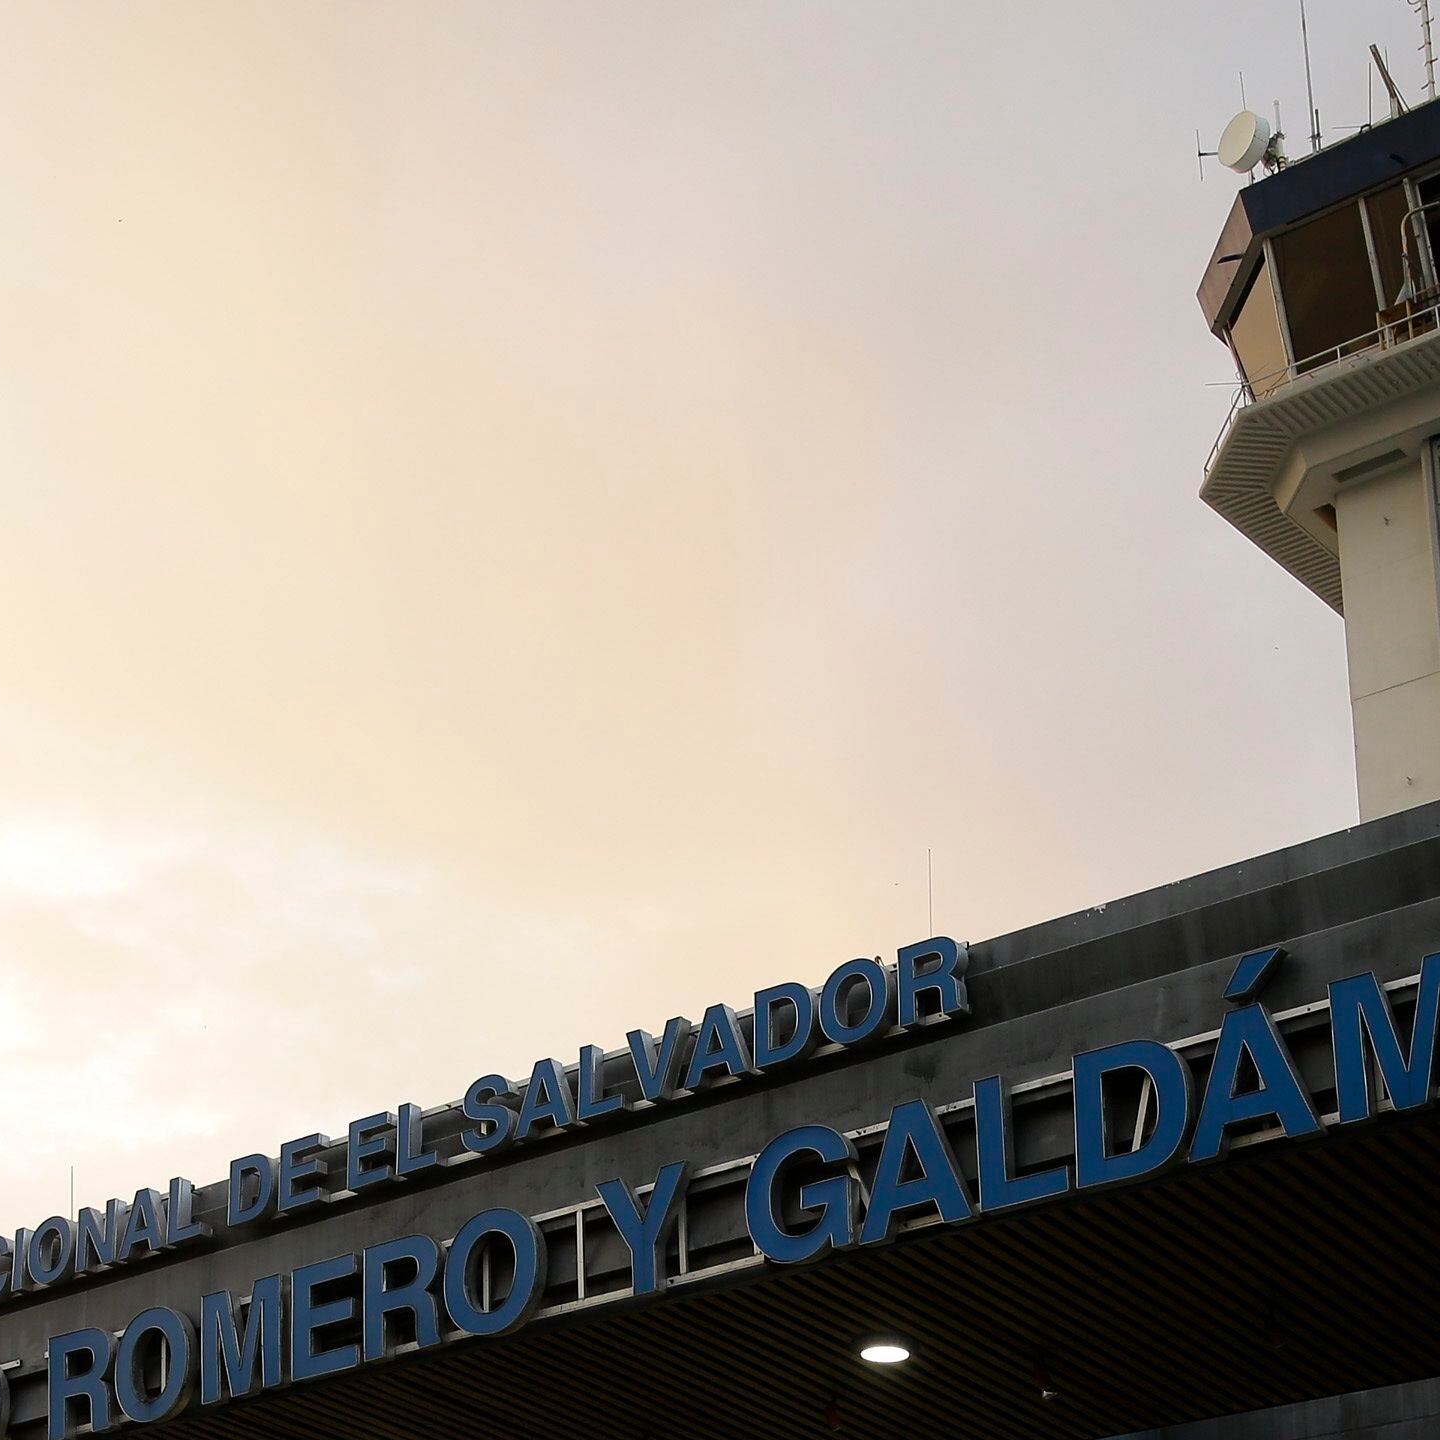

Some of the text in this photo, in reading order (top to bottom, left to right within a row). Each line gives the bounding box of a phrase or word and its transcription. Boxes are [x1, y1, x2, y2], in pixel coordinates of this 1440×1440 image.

[227, 1132, 329, 1227] DE
[346, 1103, 438, 1193] EL
[461, 936, 970, 1154] SALVADOR
[595, 1160, 688, 1295] Y
